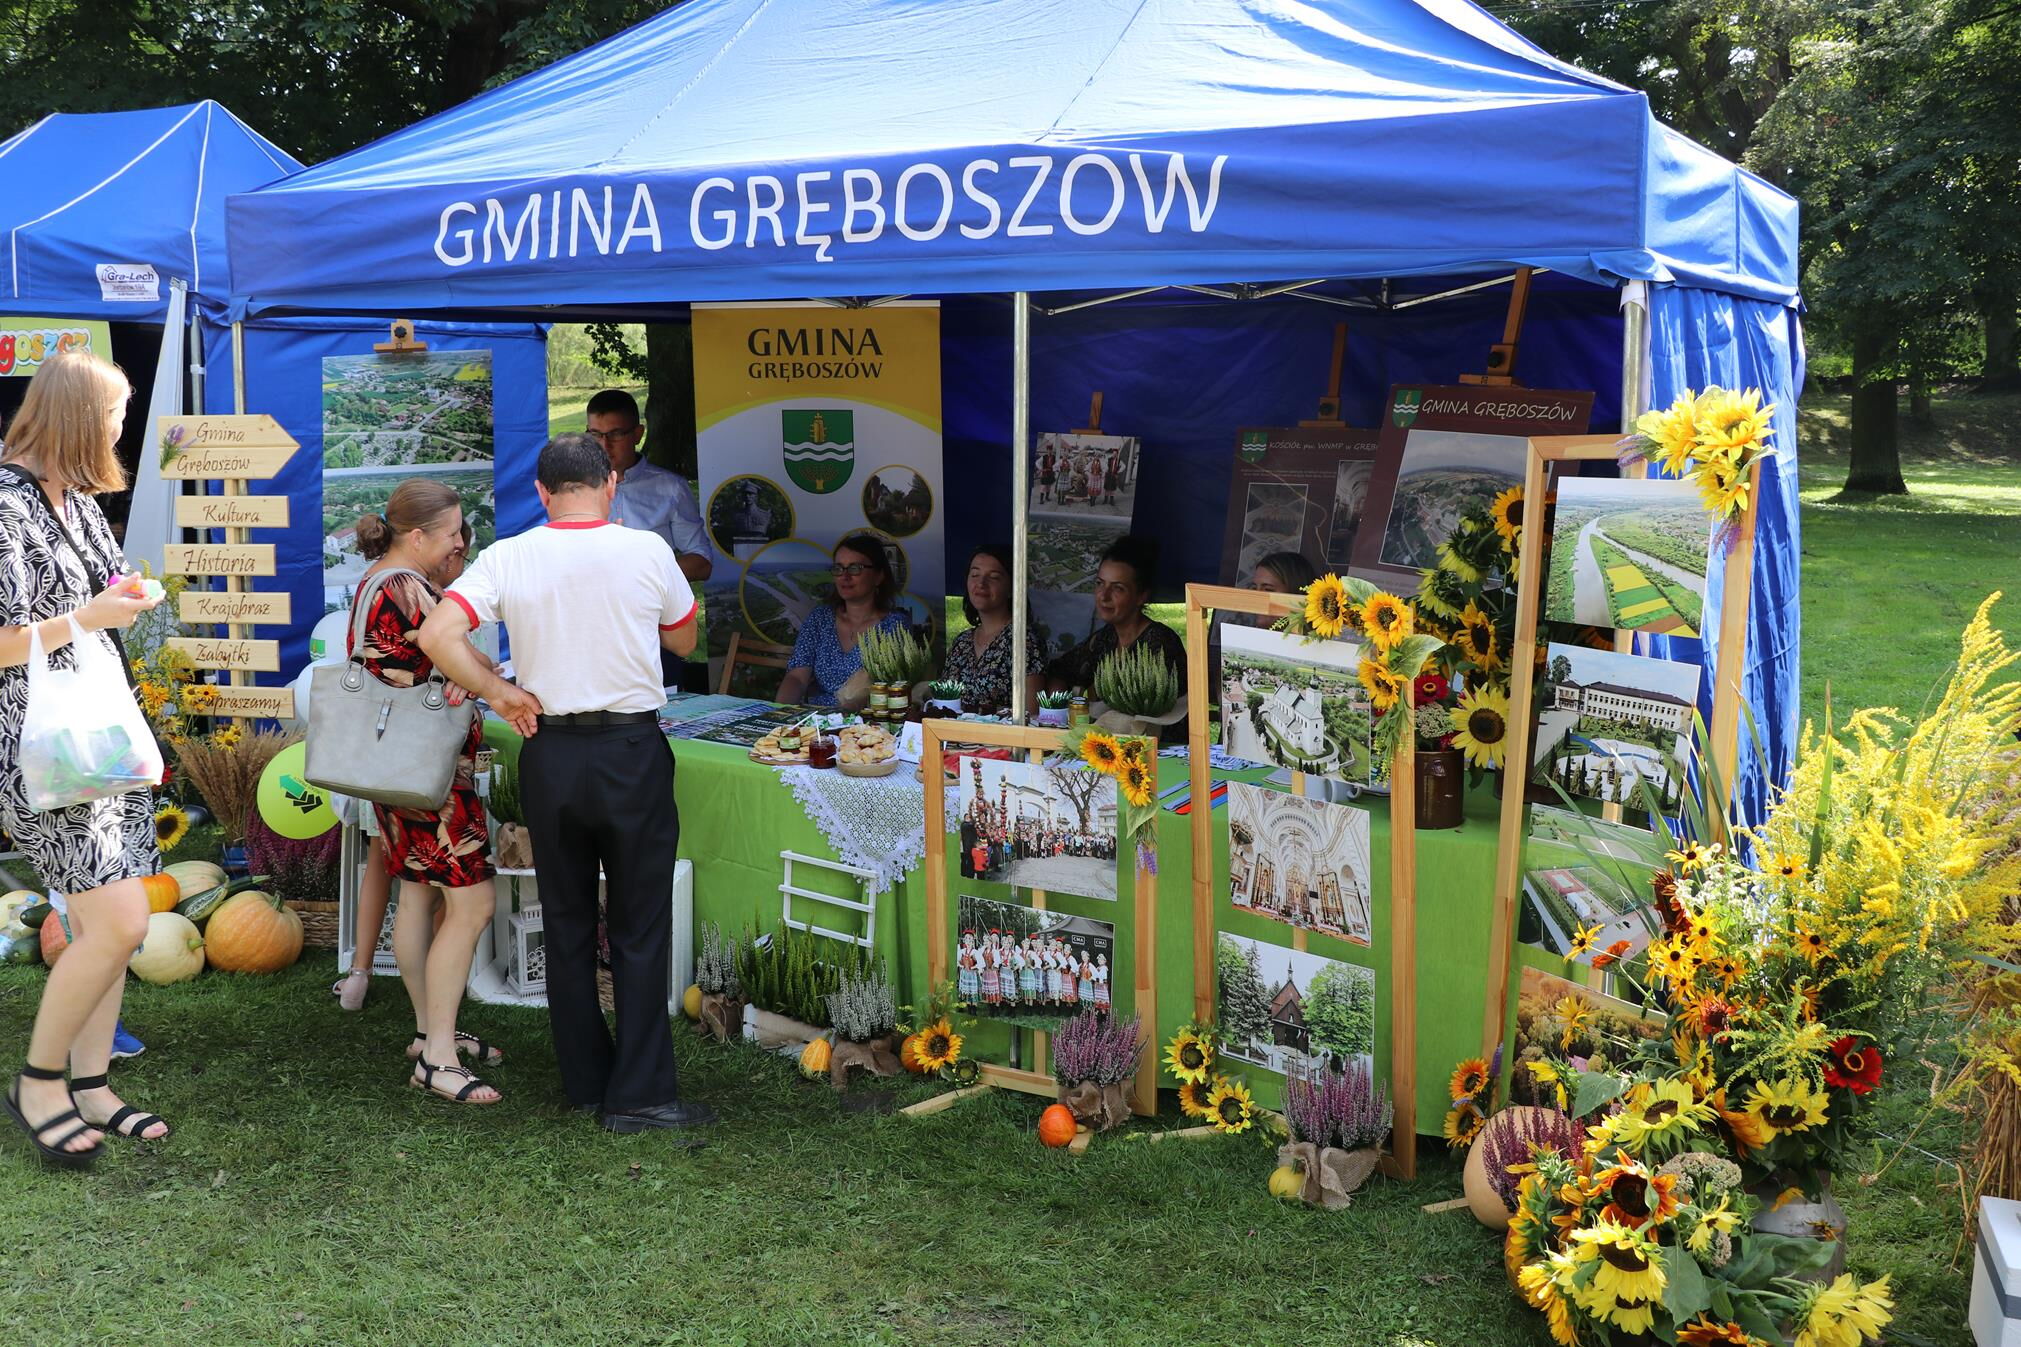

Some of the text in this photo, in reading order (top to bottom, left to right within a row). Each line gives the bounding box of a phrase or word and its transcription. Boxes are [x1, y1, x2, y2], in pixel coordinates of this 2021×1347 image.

[434, 183, 662, 266] GMINA
[747, 328, 883, 356] GMINA
[748, 358, 882, 383] GRĘBOSZÓW
[1422, 399, 1576, 421] GMINA GRĘBOSZÓW
[196, 422, 245, 443] Gmina
[177, 450, 250, 475] Gręboszów
[203, 501, 260, 523] Kultura
[184, 549, 256, 573] Historia
[197, 594, 271, 623] Krajobraz
[195, 641, 251, 669] Zabytki
